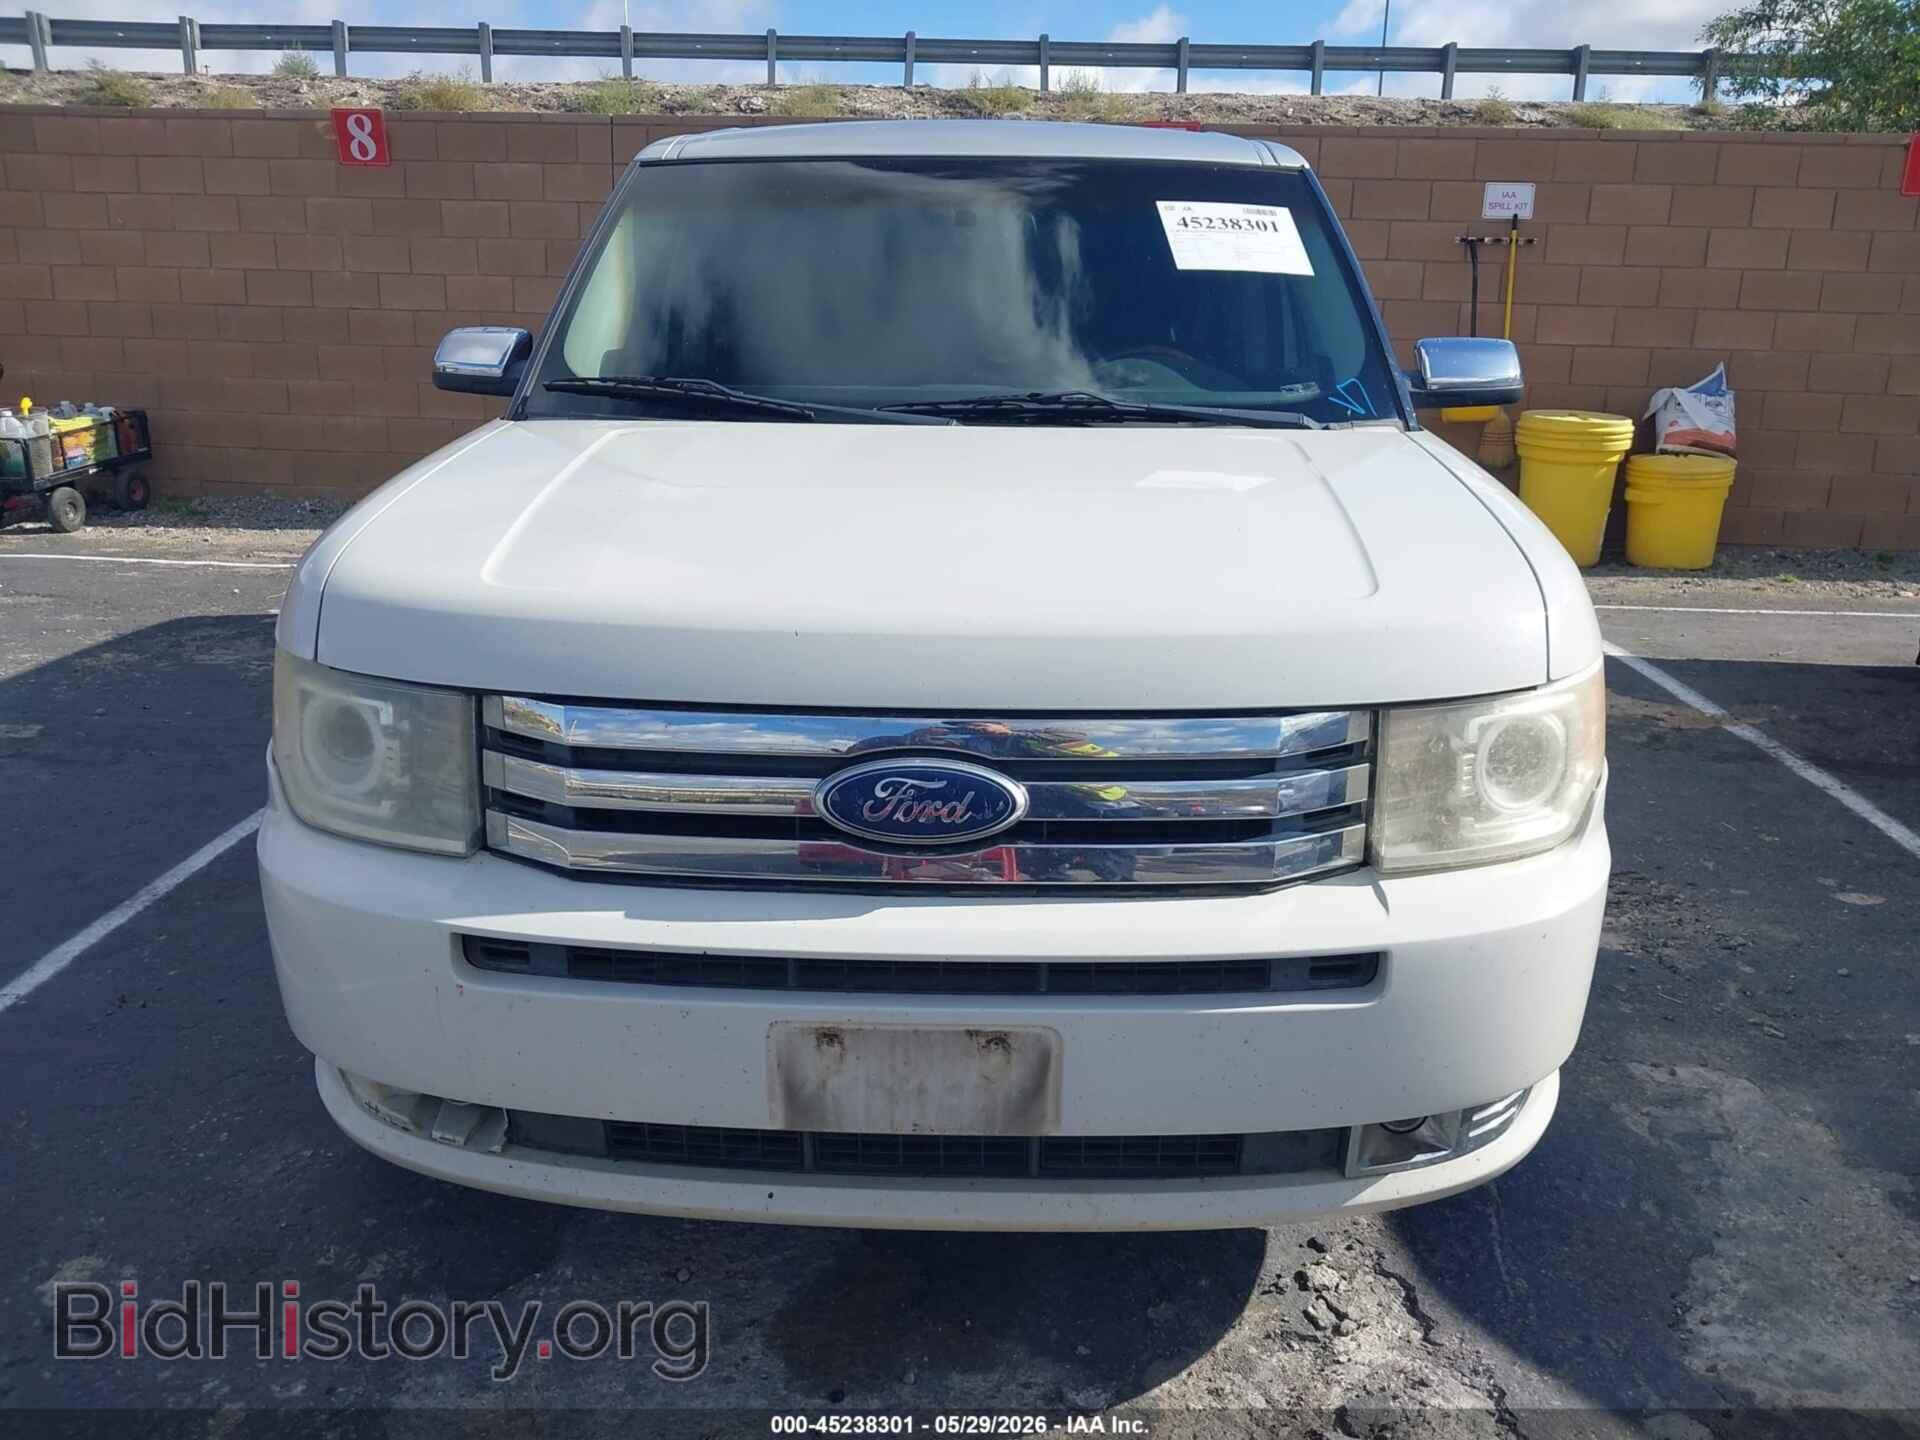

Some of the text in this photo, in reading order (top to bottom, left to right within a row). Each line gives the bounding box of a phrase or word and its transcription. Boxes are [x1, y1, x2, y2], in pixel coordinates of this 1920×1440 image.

[346, 114, 377, 160] 8
[1502, 191, 1517, 199] IAA
[1488, 202, 1529, 210] SPILL KIT
[1176, 216, 1280, 233] 45238301
[863, 777, 976, 824] Ford
